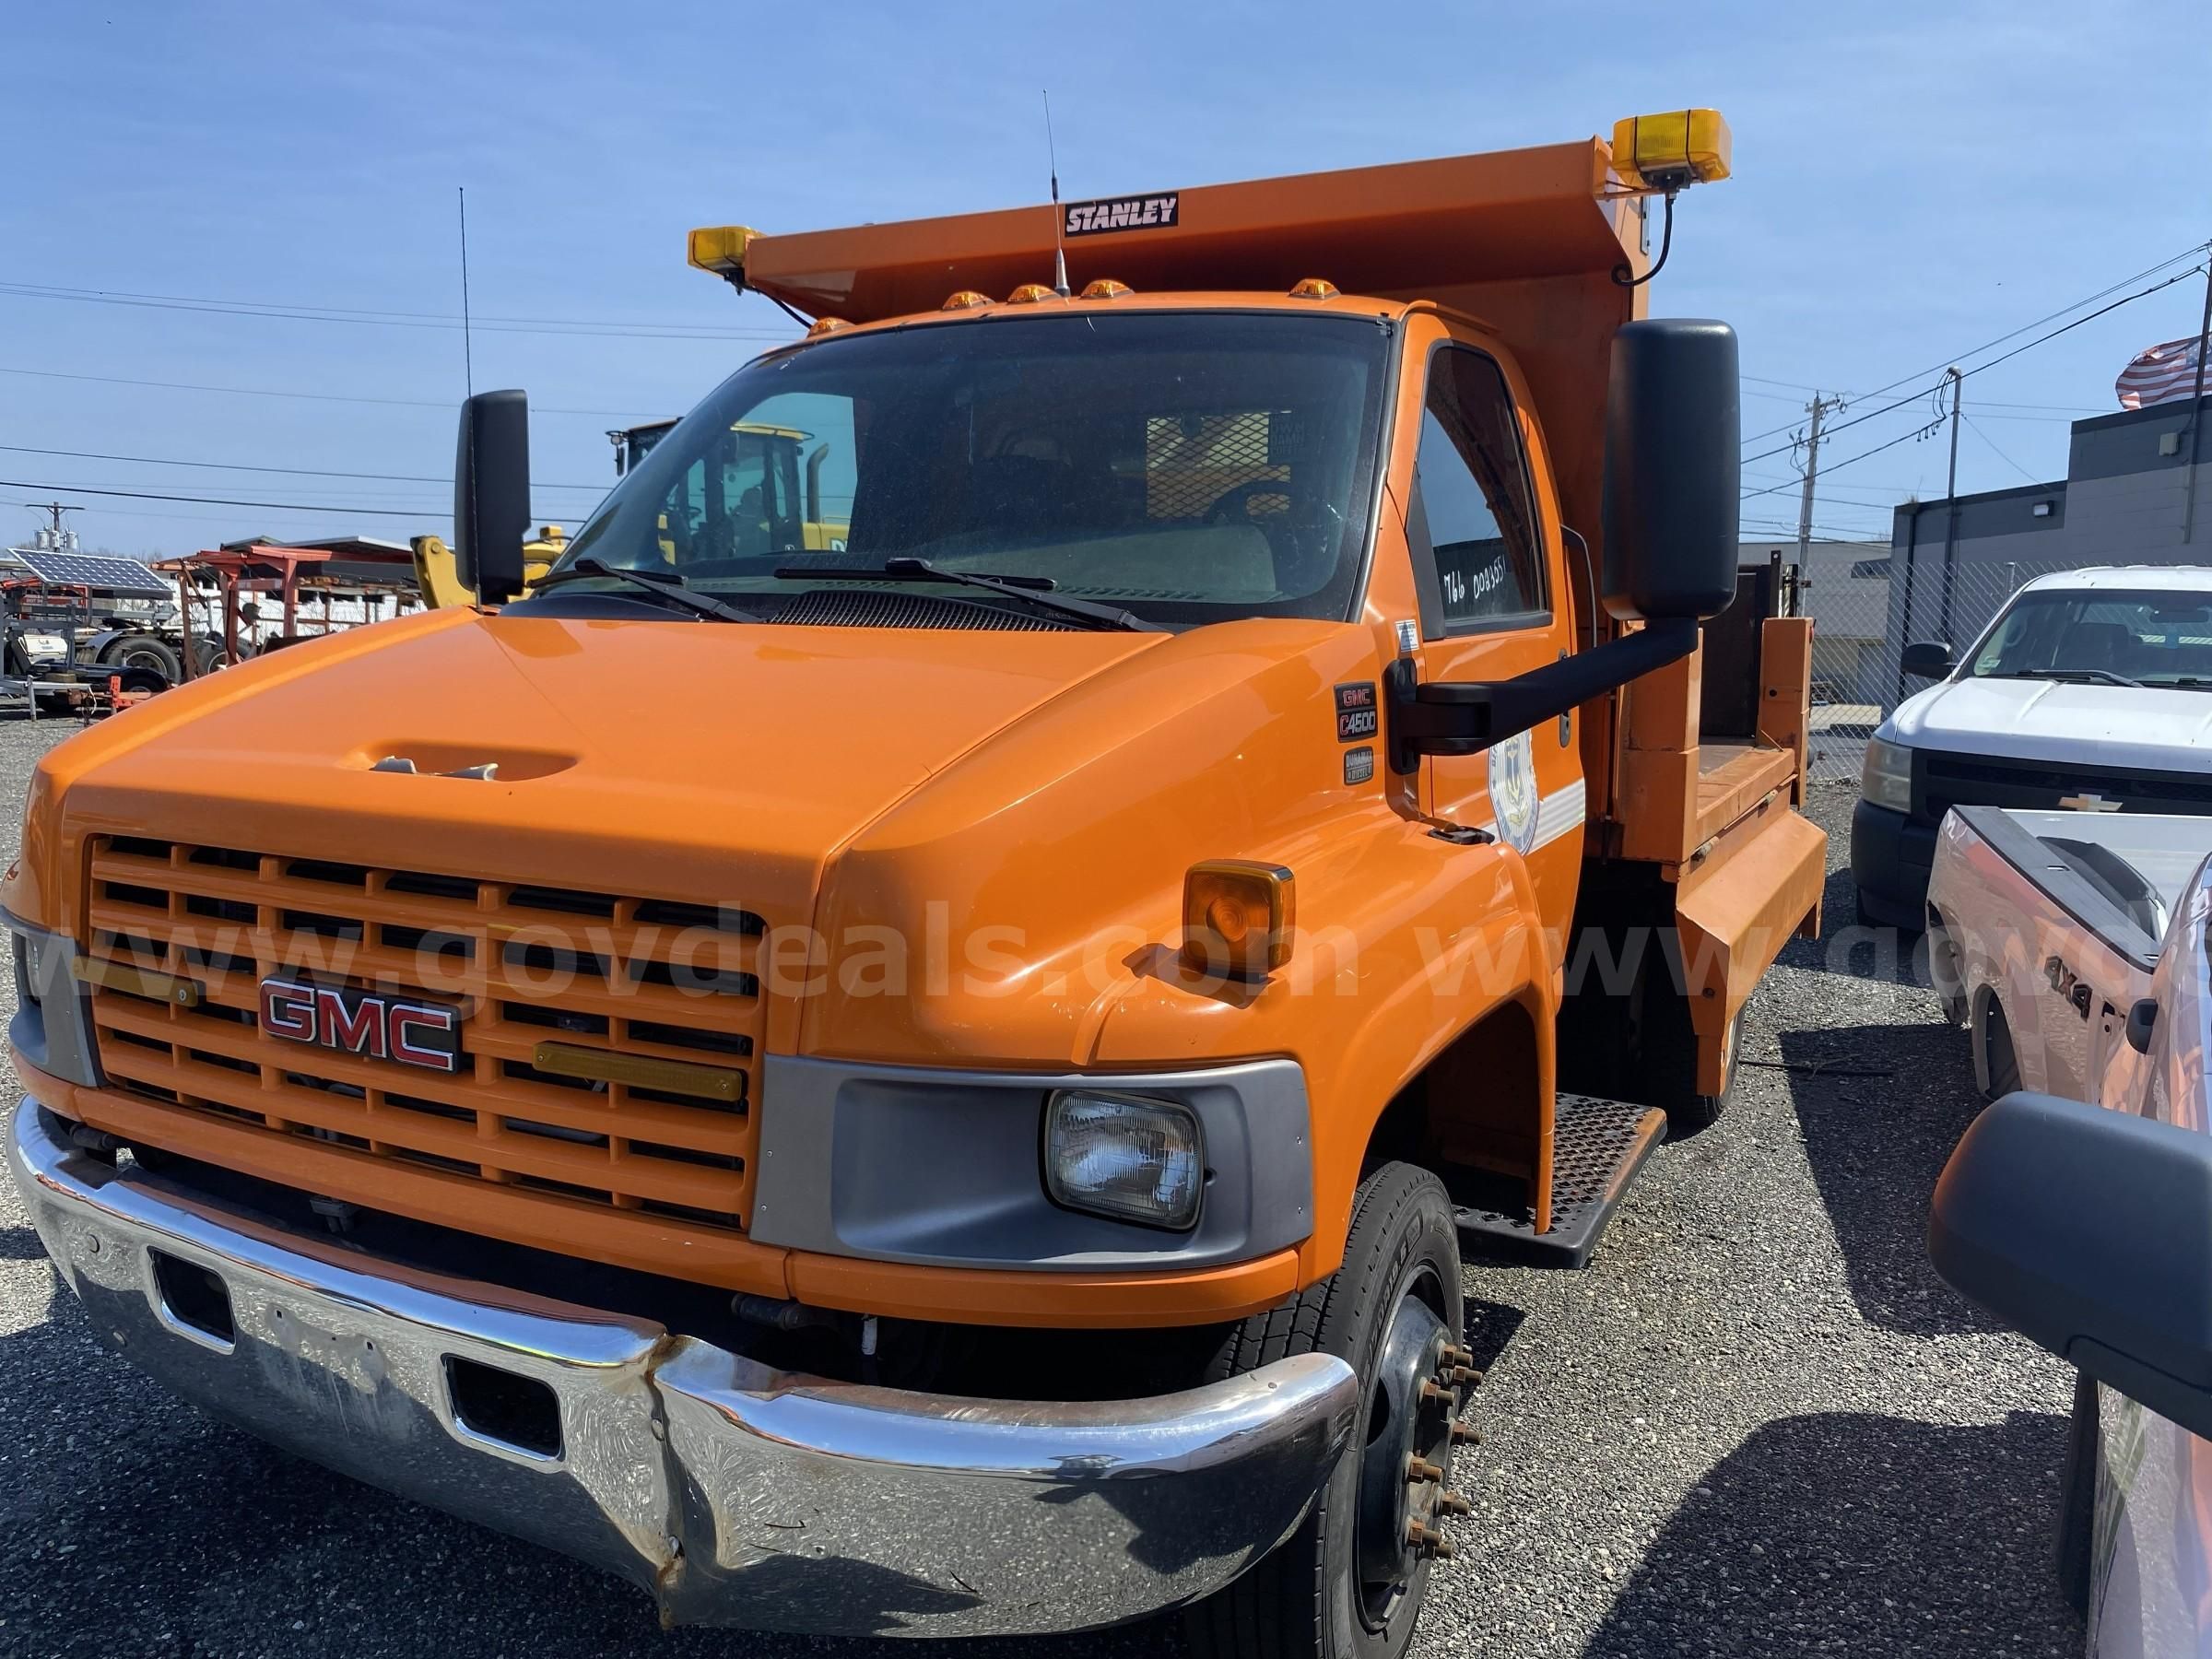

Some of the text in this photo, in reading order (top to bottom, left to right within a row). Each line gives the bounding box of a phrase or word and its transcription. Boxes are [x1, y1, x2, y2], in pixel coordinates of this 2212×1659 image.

[1066, 197, 1176, 233] STANLEY
[1443, 570, 1465, 605] 766
[1343, 688, 1371, 707] GMC
[1339, 711, 1375, 735] C4500
[260, 979, 453, 1071] GMC
